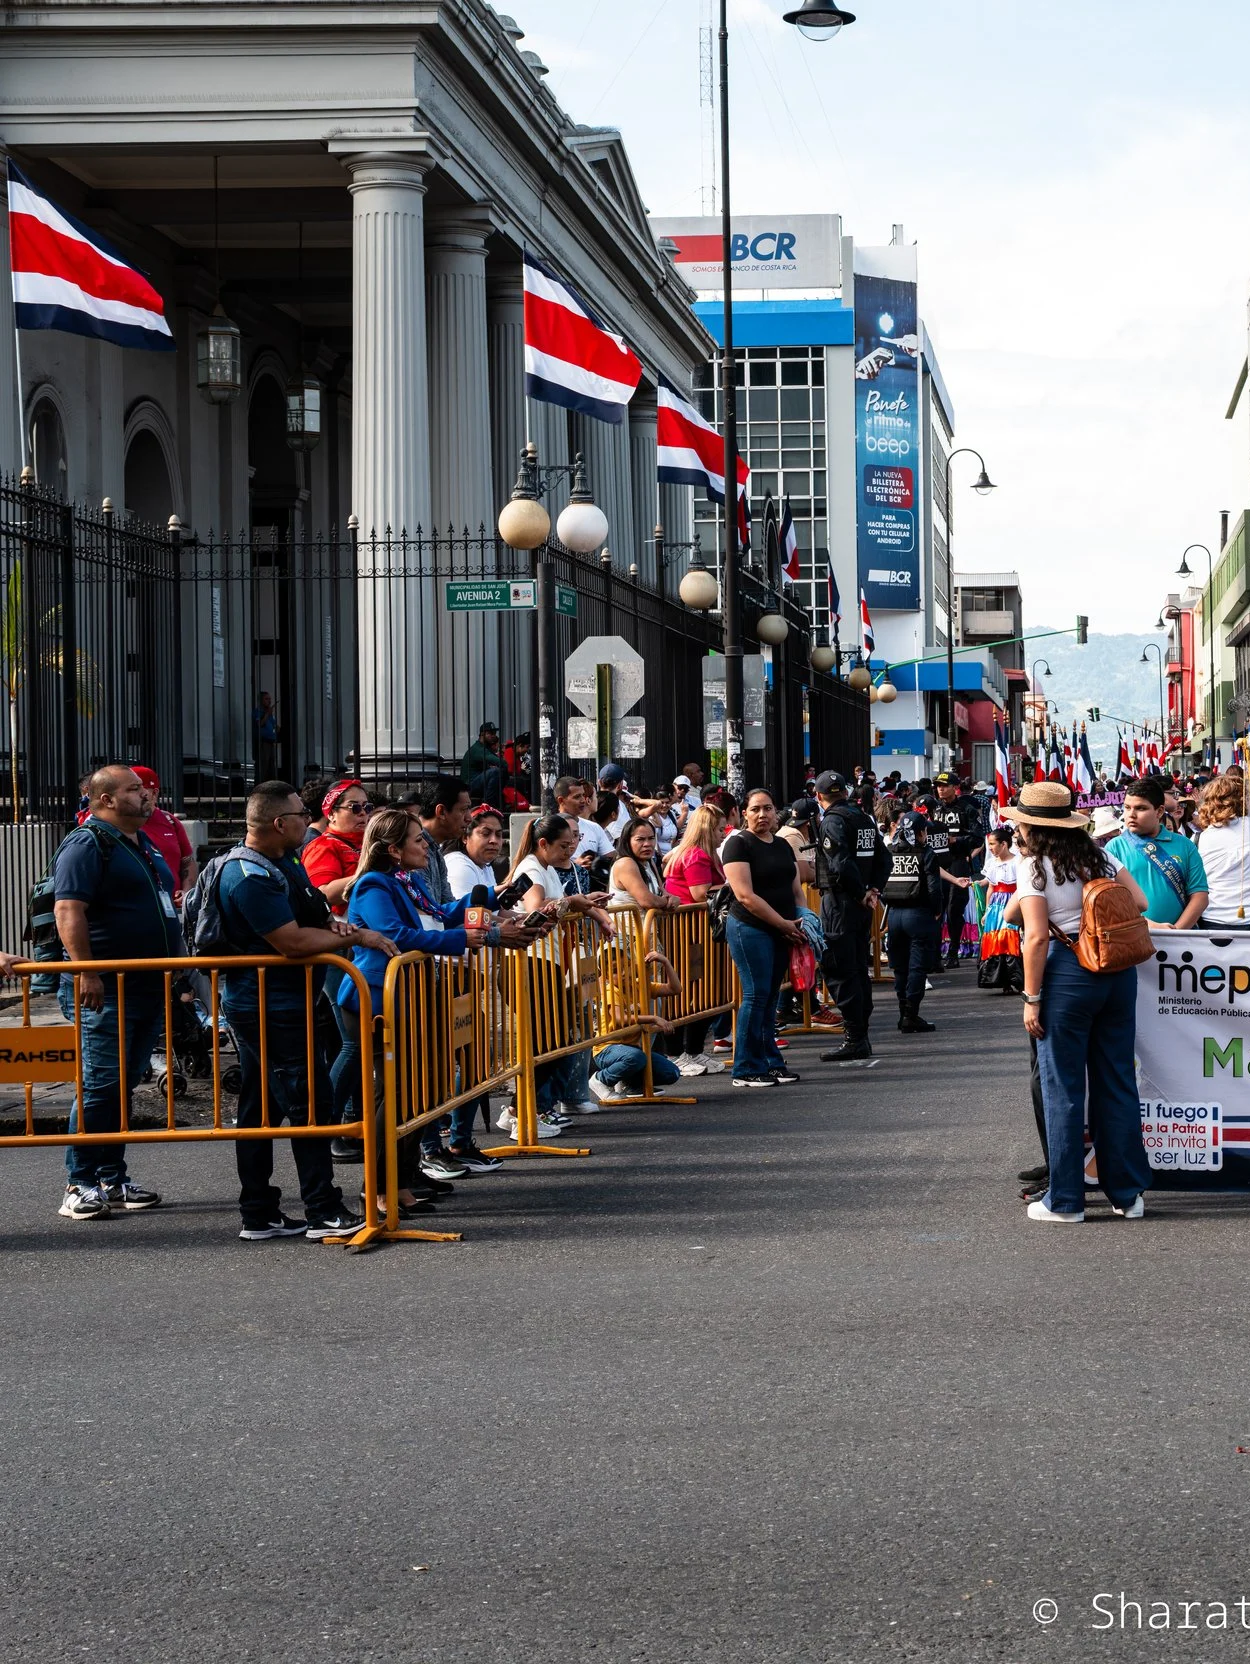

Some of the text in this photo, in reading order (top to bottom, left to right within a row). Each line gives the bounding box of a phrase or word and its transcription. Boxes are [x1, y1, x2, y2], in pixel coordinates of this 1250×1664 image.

[731, 232, 797, 261] BCR
[865, 390, 910, 415] Ponete
[874, 412, 904, 427] ritmo
[865, 431, 910, 459] beep
[882, 471, 902, 479] NUEVA
[872, 478, 905, 487] BILLETERA
[866, 485, 910, 496] ELECTRÓNICA
[875, 494, 902, 503] DEL BCR
[885, 522, 911, 530] COMPRAS
[889, 530, 910, 538] CELULAR
[877, 537, 901, 545] ANDROID
[890, 570, 911, 584] BCR
[456, 590, 501, 601] AVENIDA 2
[1158, 996, 1202, 1006] Ministerio
[1158, 1006, 1170, 1015] de
[1172, 1006, 1219, 1016] Educación
[1140, 1102, 1208, 1122] El fuego
[1157, 1123, 1168, 1133] la
[1172, 1123, 1206, 1134] Patria
[1168, 1135, 1207, 1149] invita
[1154, 1149, 1206, 1165] ser luz
